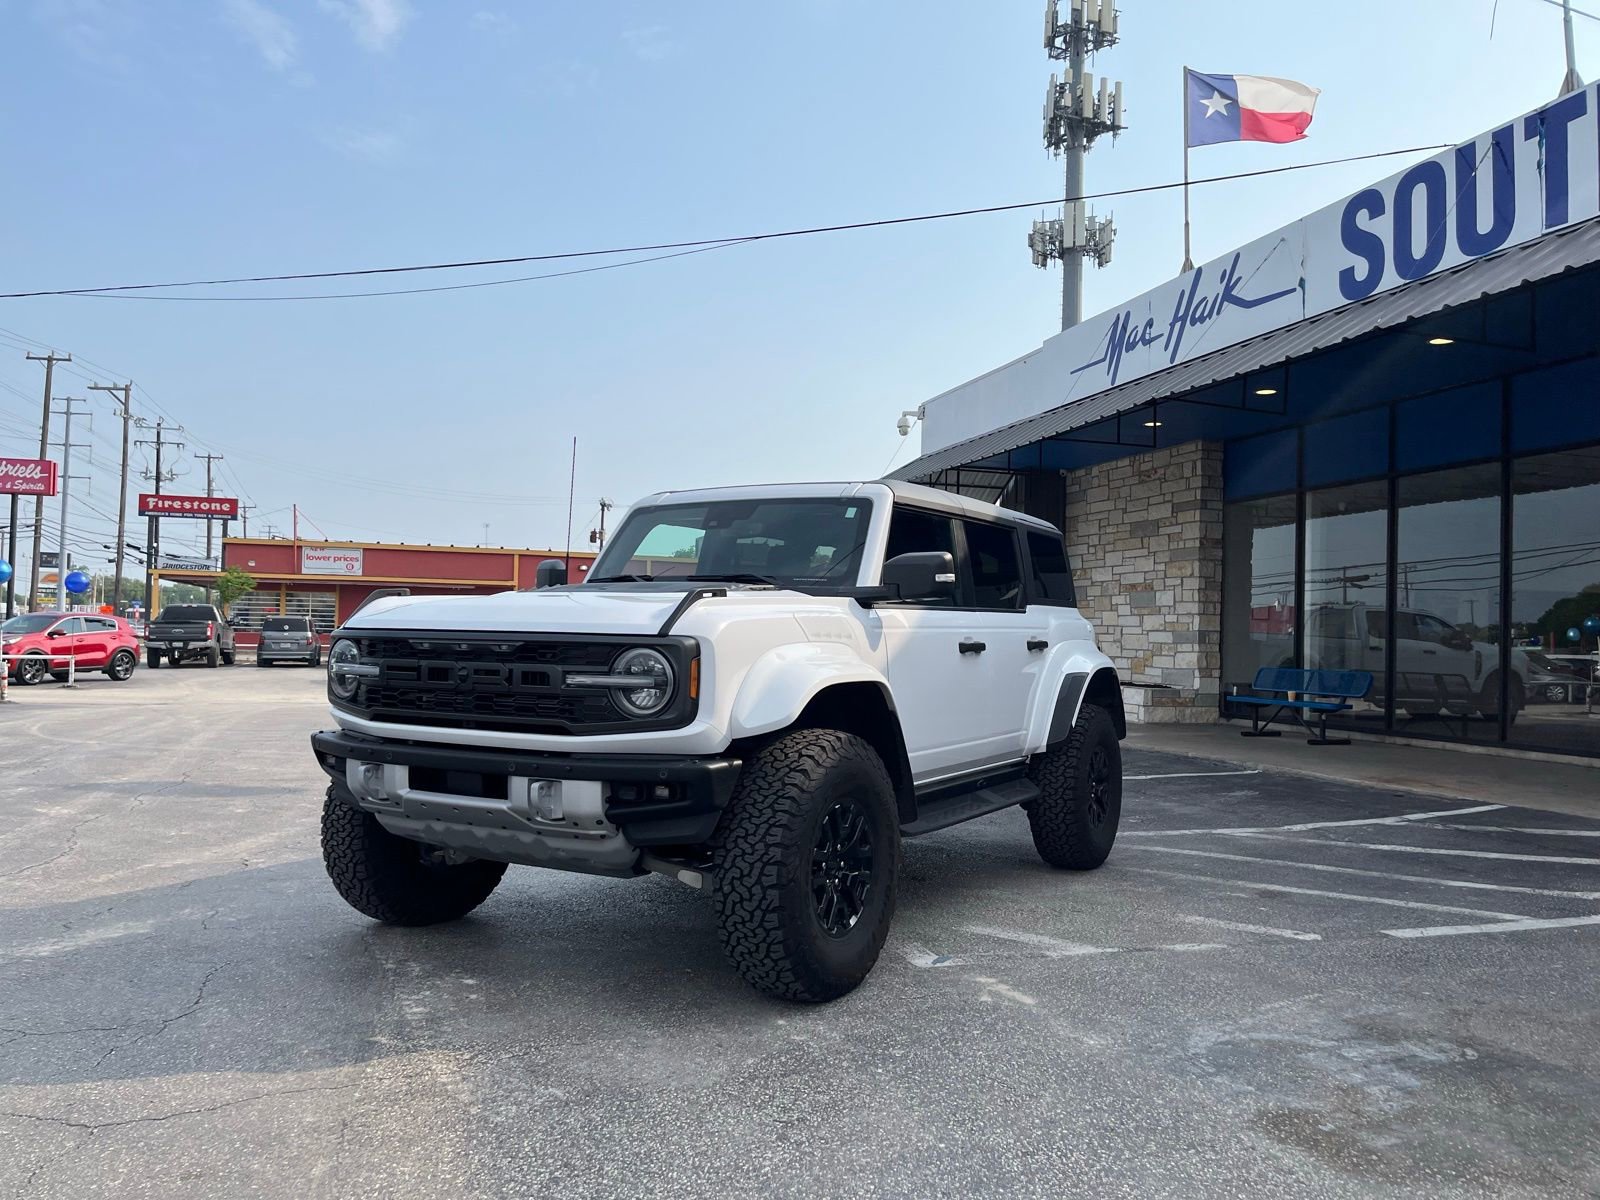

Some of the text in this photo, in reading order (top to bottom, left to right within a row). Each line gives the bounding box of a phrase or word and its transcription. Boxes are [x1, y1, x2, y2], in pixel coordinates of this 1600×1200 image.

[1070, 82, 1600, 386] Mac Haik SOUT
[13, 480, 45, 492] Spirits
[146, 497, 230, 511] Firestone
[306, 553, 359, 563] lower prices
[161, 562, 210, 571] BRIDGESTONE
